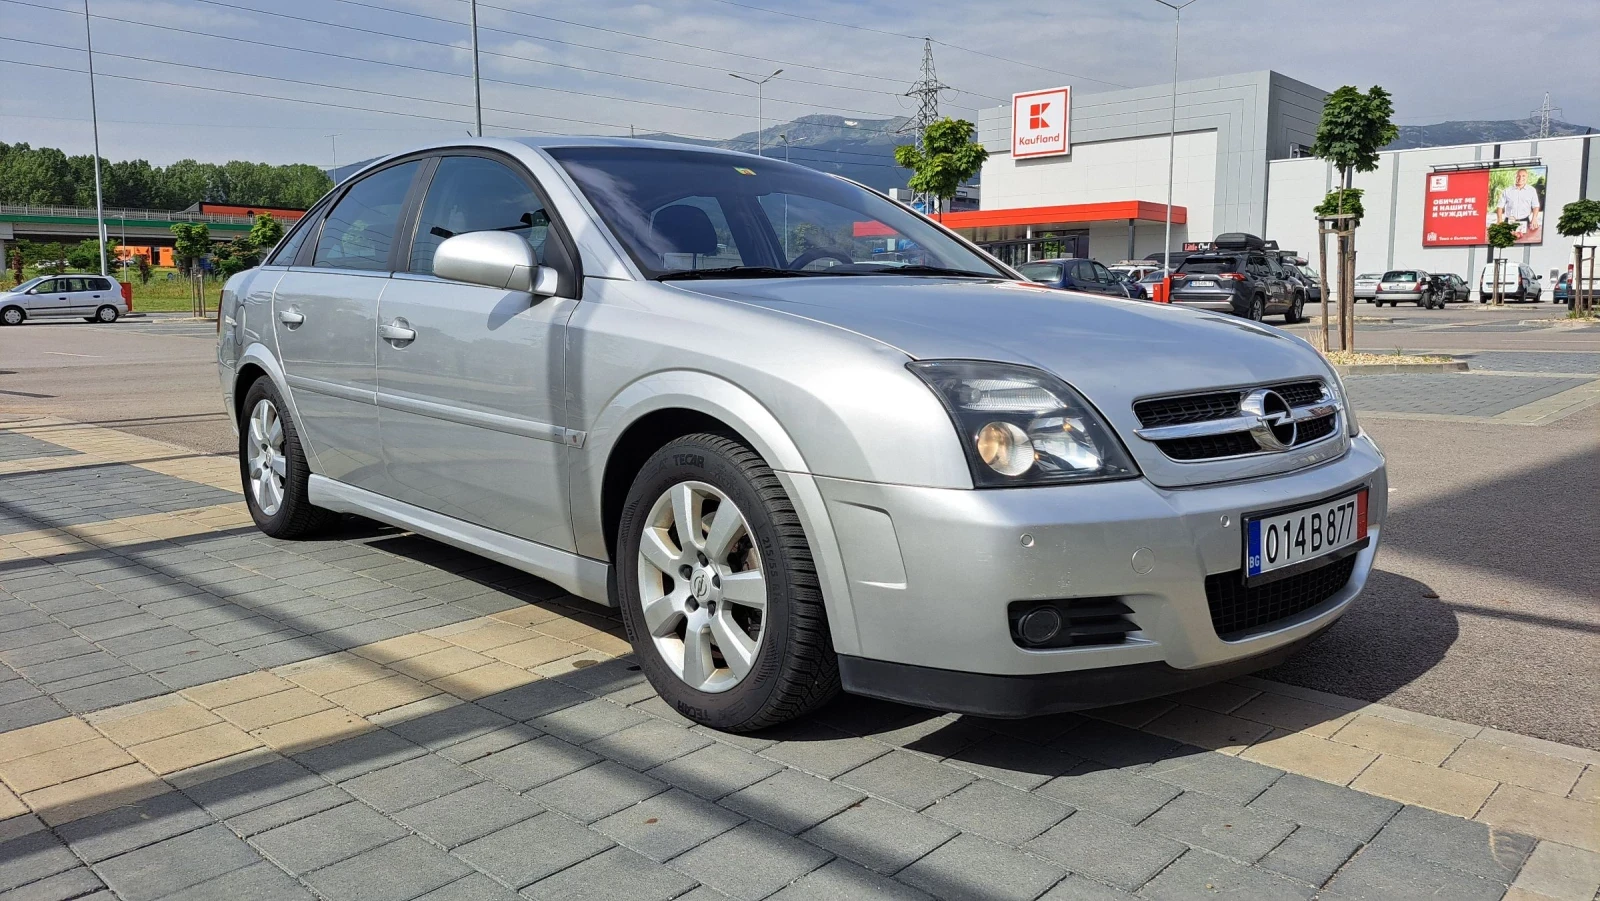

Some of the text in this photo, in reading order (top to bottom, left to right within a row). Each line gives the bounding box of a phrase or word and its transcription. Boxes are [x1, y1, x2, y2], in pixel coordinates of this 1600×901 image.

[1030, 102, 1051, 129] K
[1019, 133, 1060, 146] Kaufland
[1184, 243, 1198, 251] Little
[672, 453, 705, 469] TECAR
[1249, 555, 1260, 568] BG
[1265, 500, 1355, 564] 014B877
[762, 536, 778, 577] 215/55
[677, 699, 712, 721] TECAR
